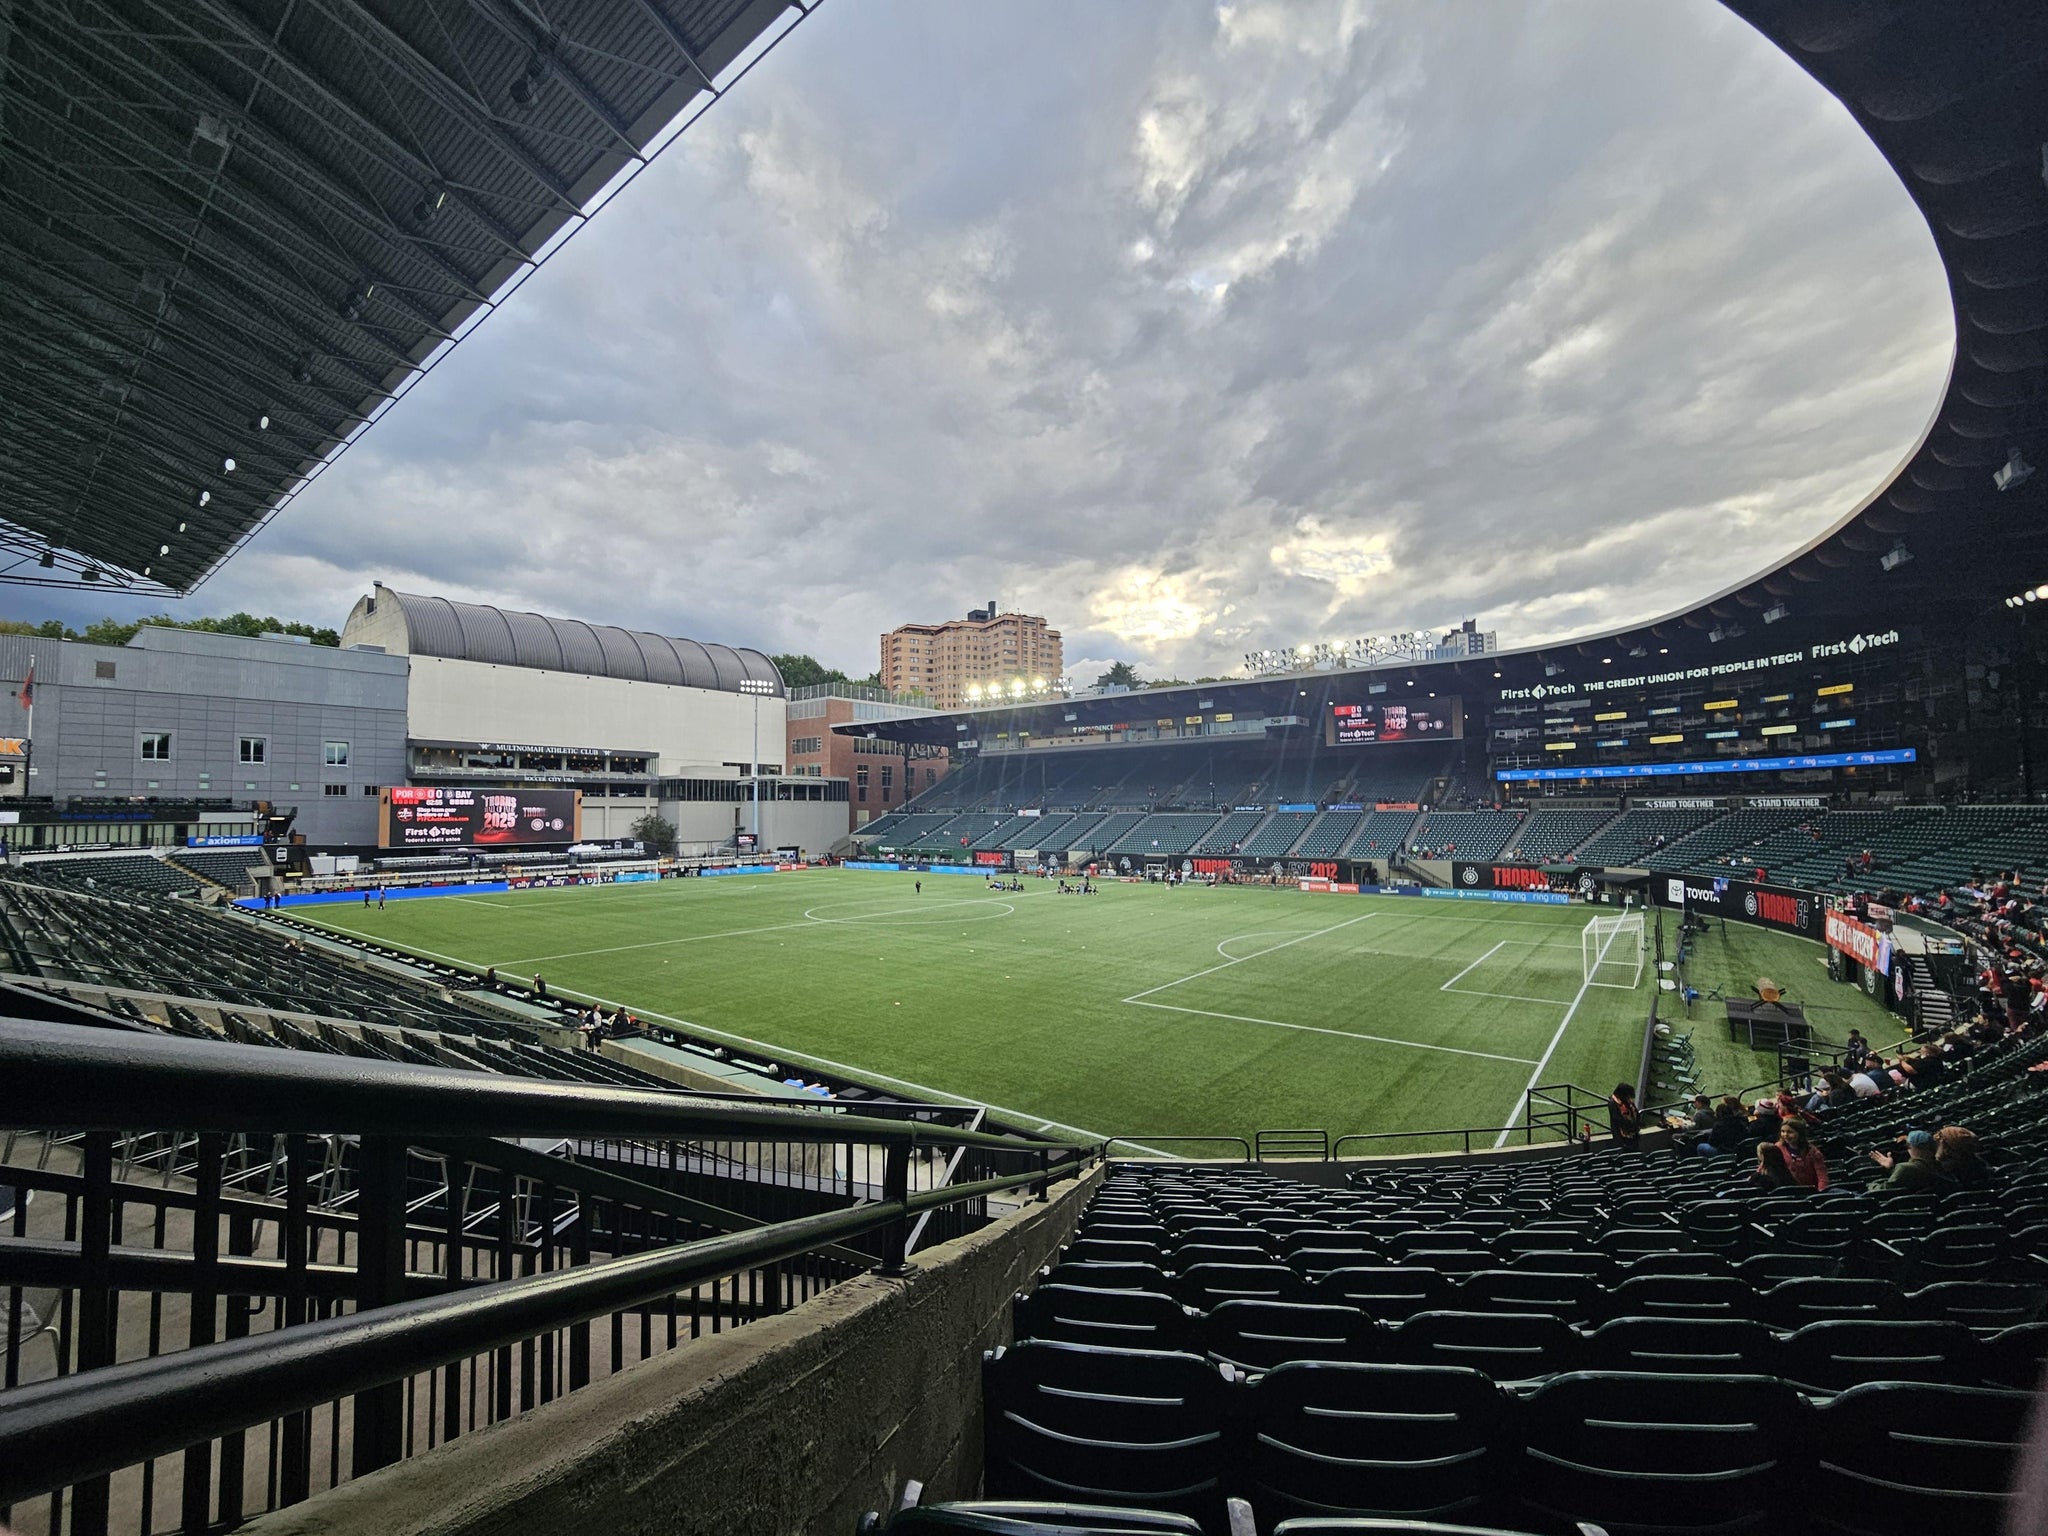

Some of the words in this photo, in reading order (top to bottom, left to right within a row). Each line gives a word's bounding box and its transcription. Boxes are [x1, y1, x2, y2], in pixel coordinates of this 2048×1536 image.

[1812, 642, 1847, 660] First
[1866, 630, 1899, 648] Tech
[1584, 682, 1604, 692] THE
[1606, 677, 1646, 688] CREDIT
[1648, 672, 1685, 684] UNION
[1687, 666, 1710, 679] FOR
[1712, 660, 1754, 676] PEOPLE
[1757, 657, 1770, 668] IN
[1770, 652, 1802, 666] TECH
[1502, 688, 1530, 699] First
[1547, 684, 1575, 696] Tech
[1384, 718, 1406, 730] 2025
[496, 744, 544, 753] MULTNOMAH
[546, 746, 578, 754] ATHLETIC
[1803, 758, 1816, 766] ring
[1861, 754, 1874, 764] ring
[1641, 767, 1652, 775] ring
[1692, 764, 1704, 772] ring
[1746, 762, 1760, 770] ring
[396, 790, 414, 798] POR
[428, 790, 435, 798] 0
[436, 790, 443, 798] 0
[456, 790, 472, 798] BAY
[484, 795, 517, 808] THORNS
[1653, 800, 1676, 808] STAND
[1678, 800, 1714, 808] TOGETHER
[1758, 799, 1782, 808] STAND
[1784, 798, 1820, 807] TOGETHER
[484, 812, 516, 828] 2025
[405, 828, 428, 836] First
[440, 828, 462, 836] Tech
[208, 837, 240, 845] axiom
[1310, 862, 1338, 879] 2012
[1493, 868, 1548, 887] THORNS
[516, 880, 530, 889] ally
[534, 880, 548, 888] ally
[552, 879, 565, 887] ally
[1493, 892, 1508, 901] ring
[1511, 892, 1527, 902] ring
[1533, 892, 1549, 903] ring
[1552, 893, 1568, 903] ring
[1756, 892, 1798, 925] THORNS
[1795, 899, 1809, 930] FC
